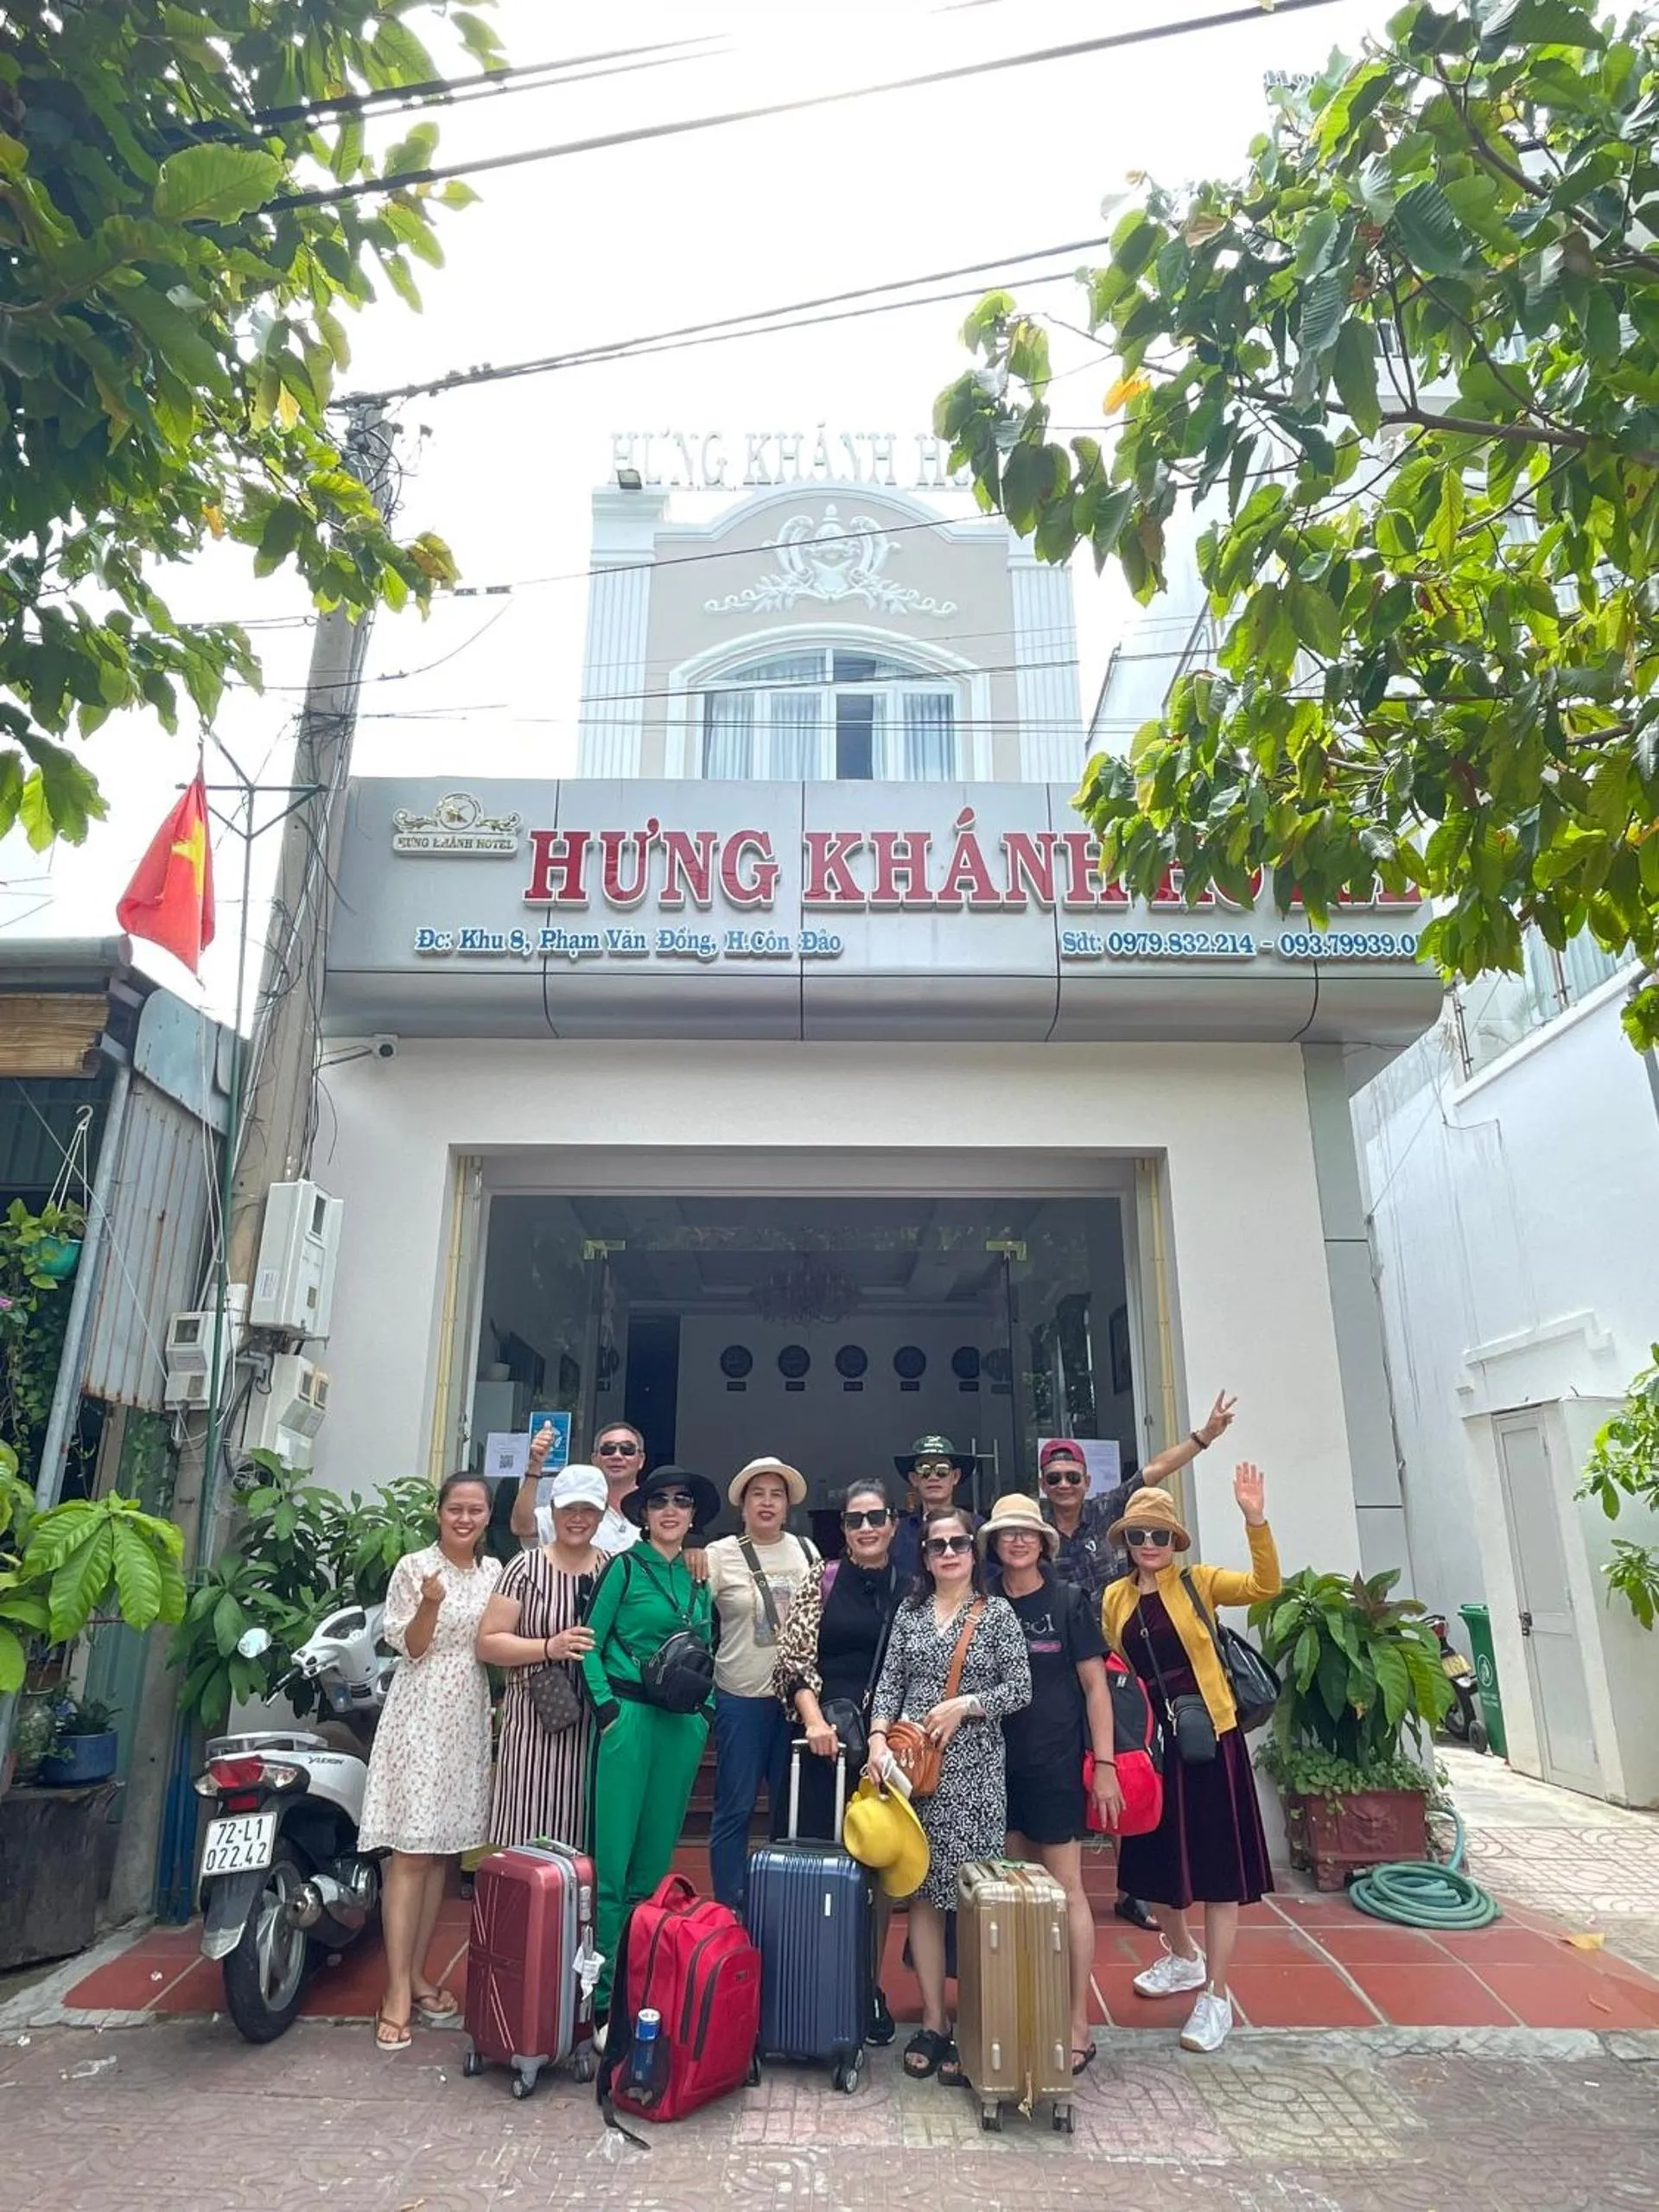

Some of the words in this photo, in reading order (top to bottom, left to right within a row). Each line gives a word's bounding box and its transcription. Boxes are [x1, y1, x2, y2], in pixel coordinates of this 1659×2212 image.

[524, 817, 779, 902] HƯNG
[803, 807, 1131, 904] KHÁNH
[459, 929, 504, 949] Khu
[509, 929, 531, 954] 8,
[540, 929, 600, 957] Phạm
[606, 929, 646, 950] Văn
[800, 928, 842, 950] Đảo
[1108, 932, 1253, 953] 0979.832.214
[207, 1842, 266, 1870] 022.42
